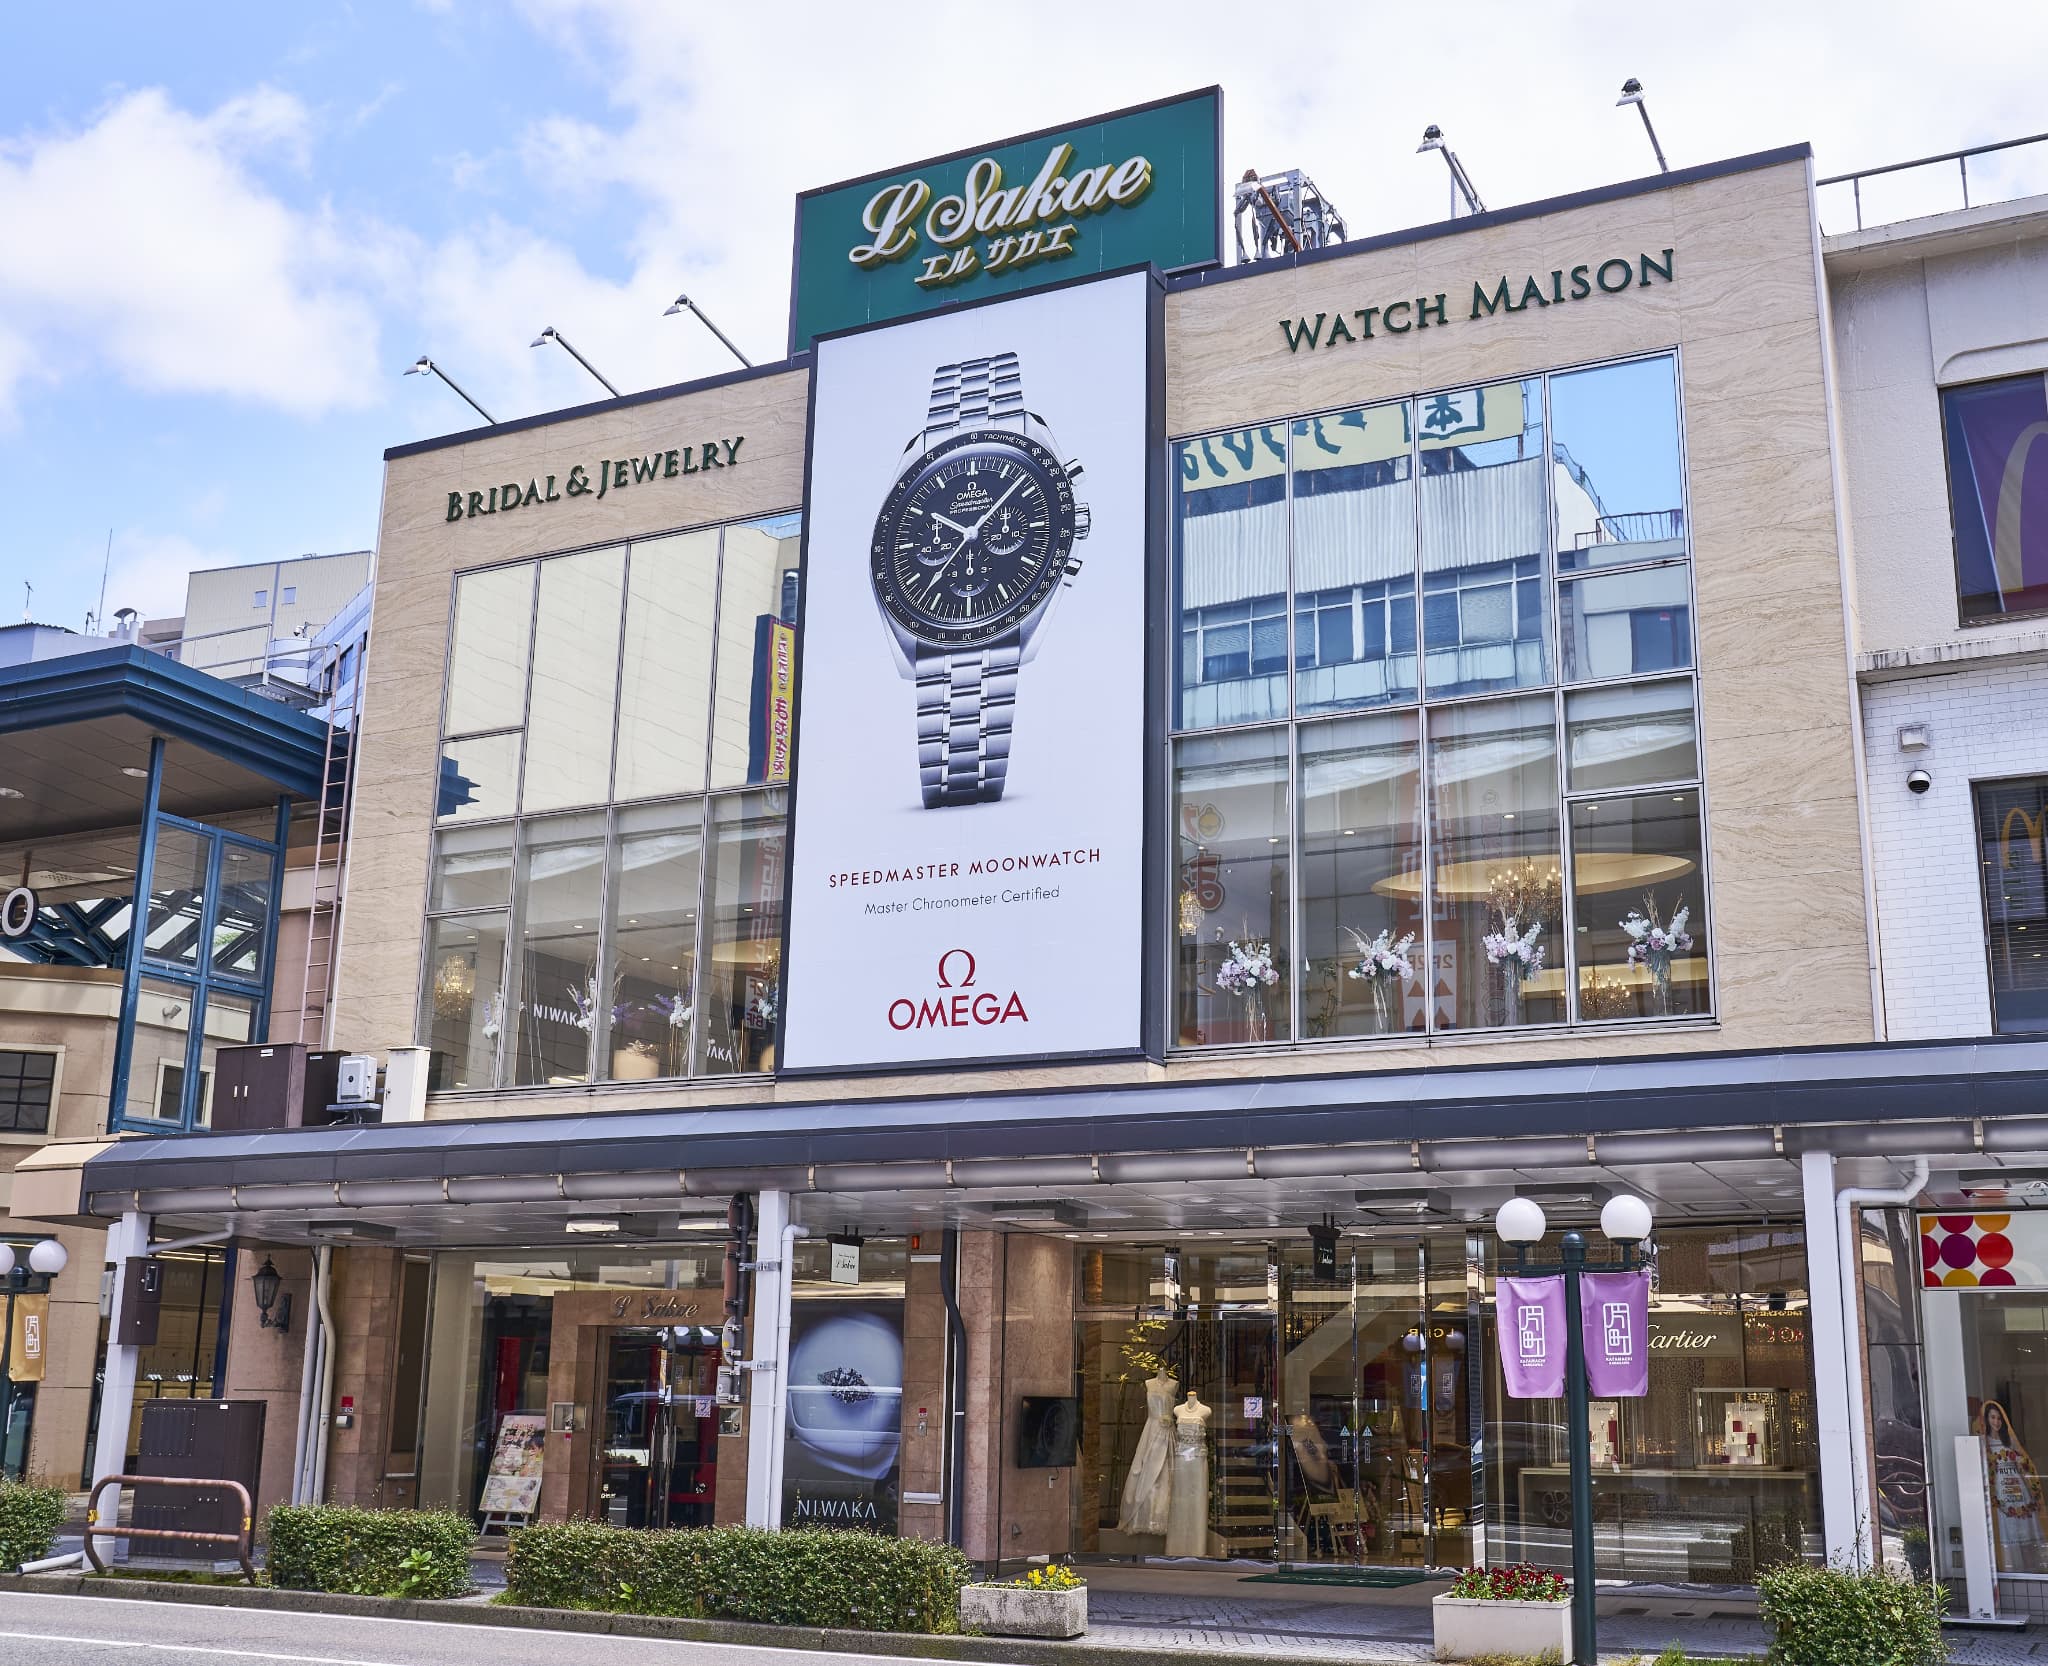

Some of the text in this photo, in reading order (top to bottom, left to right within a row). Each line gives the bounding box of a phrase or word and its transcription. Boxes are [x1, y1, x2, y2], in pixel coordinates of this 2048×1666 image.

[925, 142, 1152, 247] Sakae
[1279, 248, 1675, 353] WATCH MAISON
[956, 489, 988, 500] OMEGA
[829, 847, 1101, 888] SPEEDMASTER MOONWATCH
[864, 884, 1061, 916] Master Chronometer Certified
[533, 1003, 579, 1027] NIWAK
[888, 991, 1029, 1031] OMEGA
[1647, 1324, 1717, 1350] Cartier
[797, 1499, 877, 1519] NIWAKA
